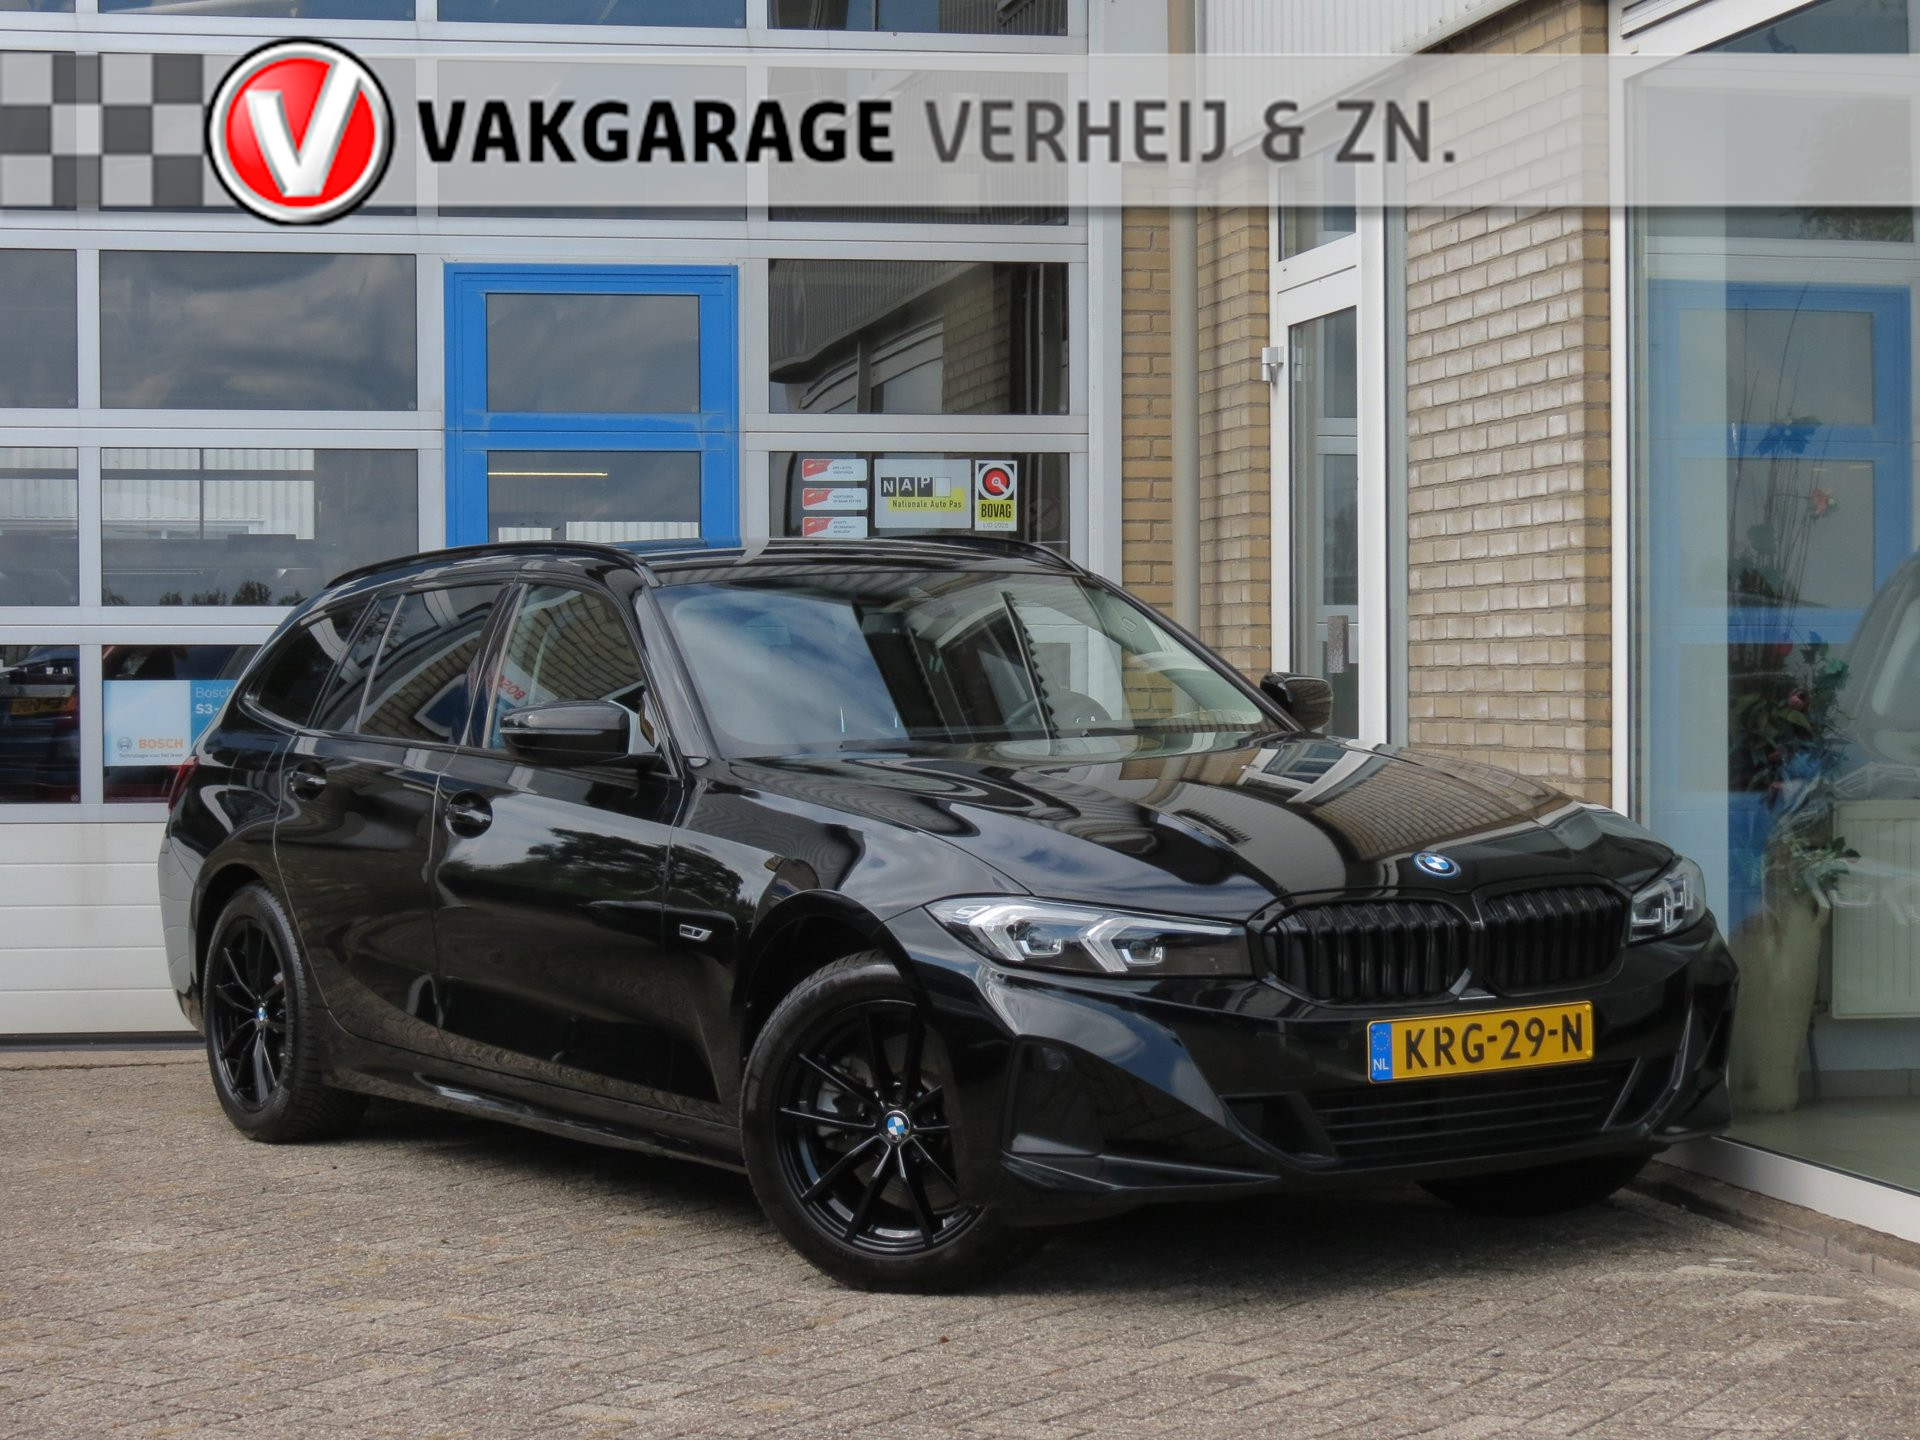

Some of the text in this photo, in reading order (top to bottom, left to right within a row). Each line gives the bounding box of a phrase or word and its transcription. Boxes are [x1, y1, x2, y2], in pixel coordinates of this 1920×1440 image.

[883, 476, 931, 493] NAP
[892, 499, 962, 508] Nationale Auto Pas
[981, 503, 1012, 518] BOVAG
[138, 738, 183, 749] BOSCH
[1405, 1012, 1583, 1070] KRG-29-N
[1373, 1058, 1389, 1071] NL
